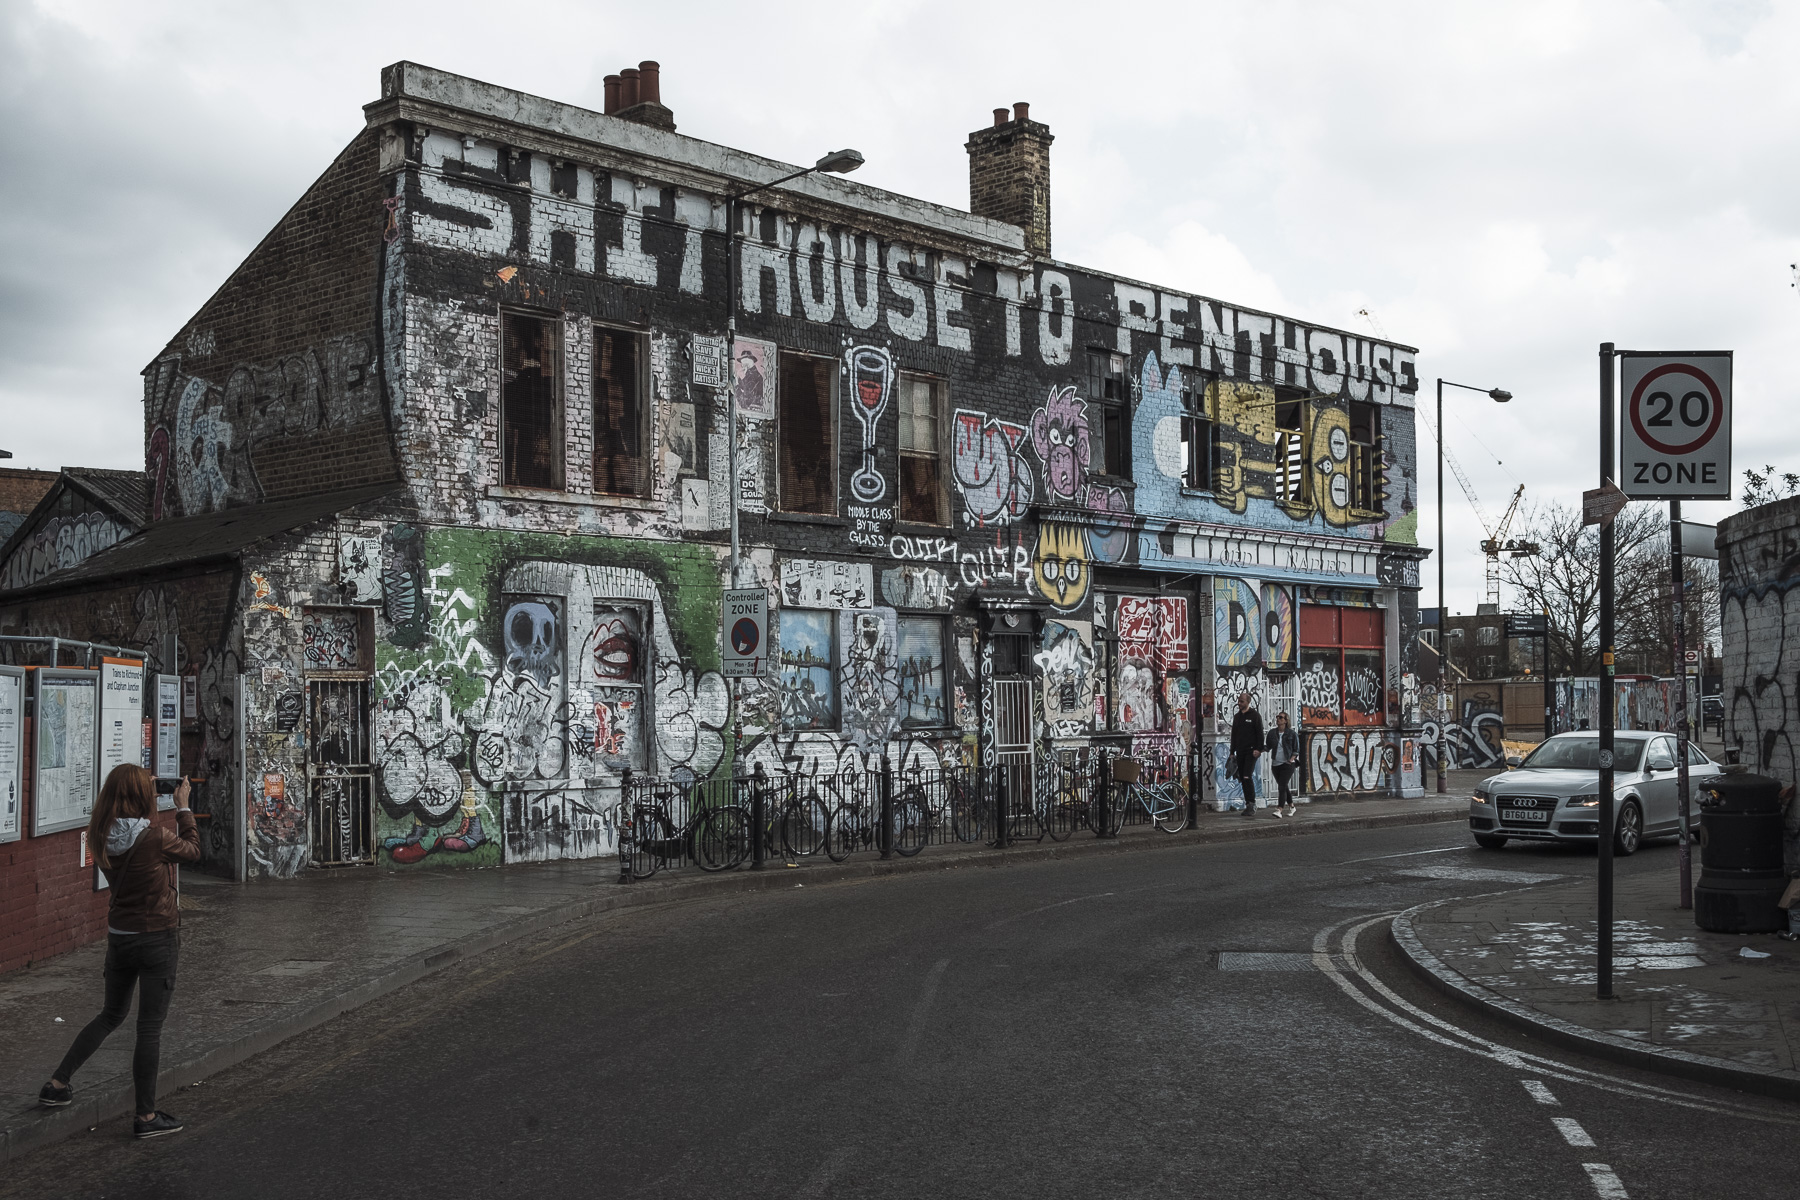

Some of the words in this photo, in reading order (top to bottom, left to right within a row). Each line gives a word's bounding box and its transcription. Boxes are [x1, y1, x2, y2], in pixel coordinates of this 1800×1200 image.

[740, 205, 972, 351] HOUSE
[996, 269, 1075, 366] TO
[1114, 281, 1416, 408] PENTHOUSE
[695, 335, 719, 347] HASHTAG
[695, 346, 713, 355] SAVE
[695, 354, 718, 366] HACKNEY
[695, 373, 718, 385] ARTISTS
[1646, 391, 1710, 427] 20
[1633, 462, 1717, 484] ZONE
[847, 505, 870, 519] MIDDLE
[871, 507, 892, 520] CLASS
[856, 519, 866, 530] BY
[867, 521, 880, 533] THE
[1207, 541, 1253, 569] LORD
[1283, 550, 1347, 577] NAPIER
[725, 592, 765, 602] Controlled
[731, 604, 759, 614] ZONE
[112, 668, 121, 678] Trains
[126, 670, 140, 680] Richmond
[114, 681, 127, 692] Clapham
[127, 682, 139, 691] Junction
[1504, 811, 1526, 819] BT60
[1527, 811, 1544, 820] LGJ
